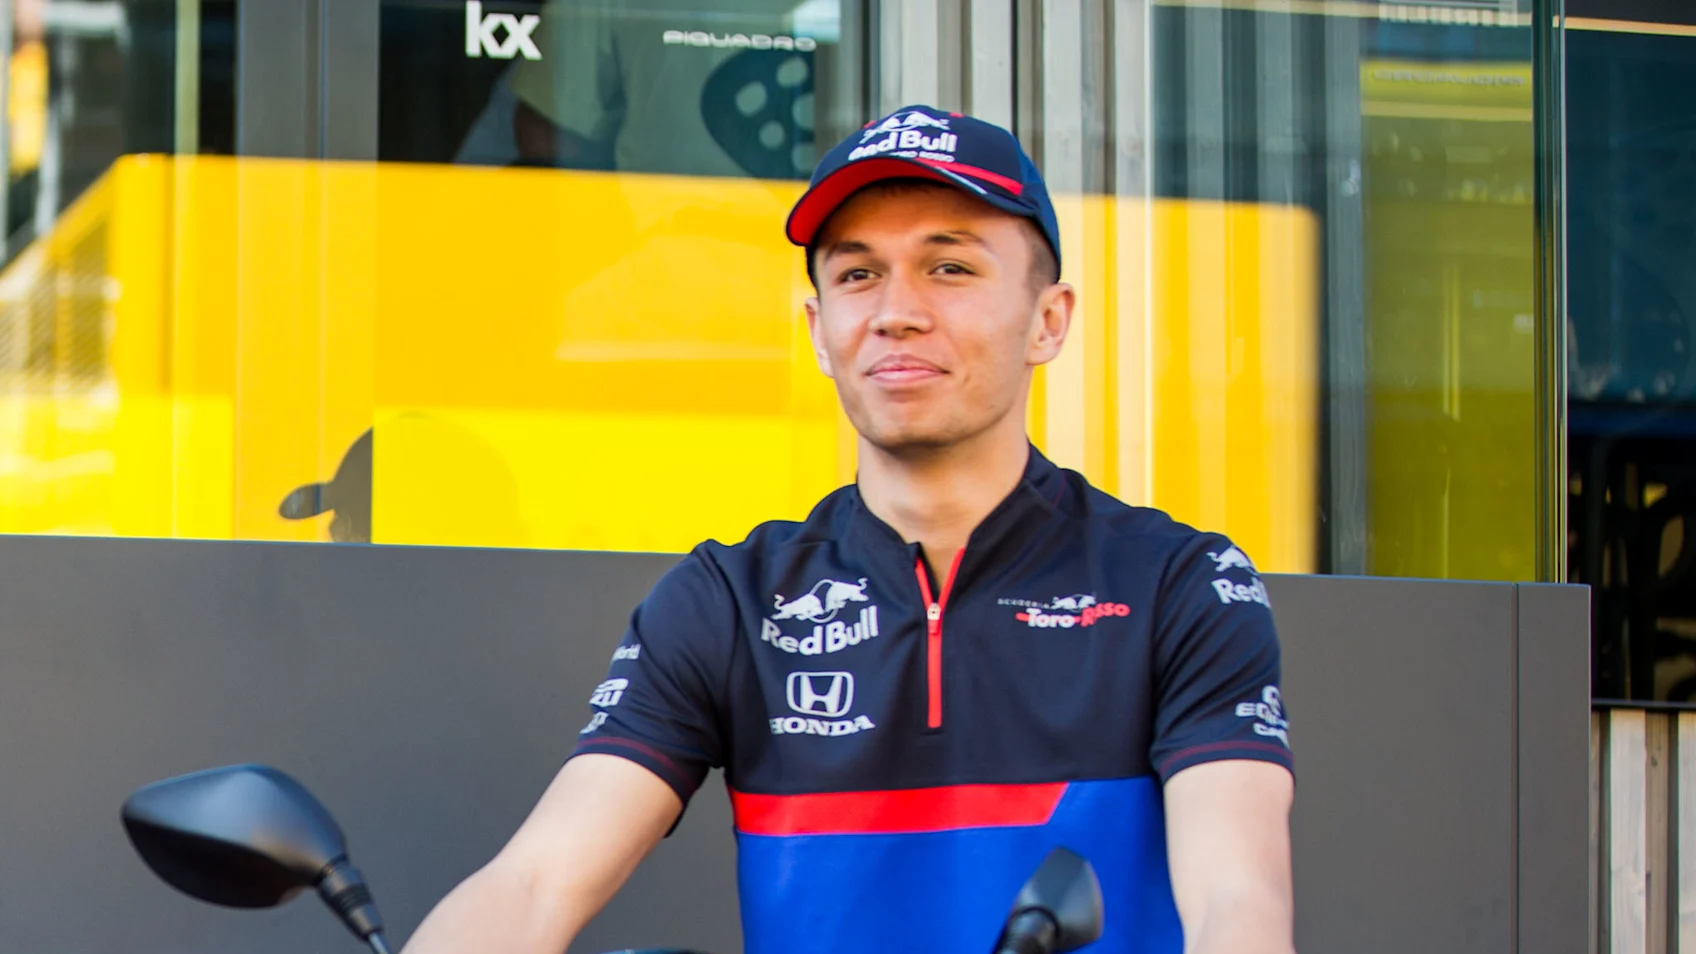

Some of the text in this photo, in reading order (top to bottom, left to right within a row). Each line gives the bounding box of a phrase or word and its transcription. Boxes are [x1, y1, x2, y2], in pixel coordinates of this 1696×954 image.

[465, 1, 543, 60] kx
[662, 30, 817, 52] PIQUADRO
[898, 130, 958, 152] Bull
[1025, 607, 1075, 628] Toro
[769, 714, 876, 737] HONDA
